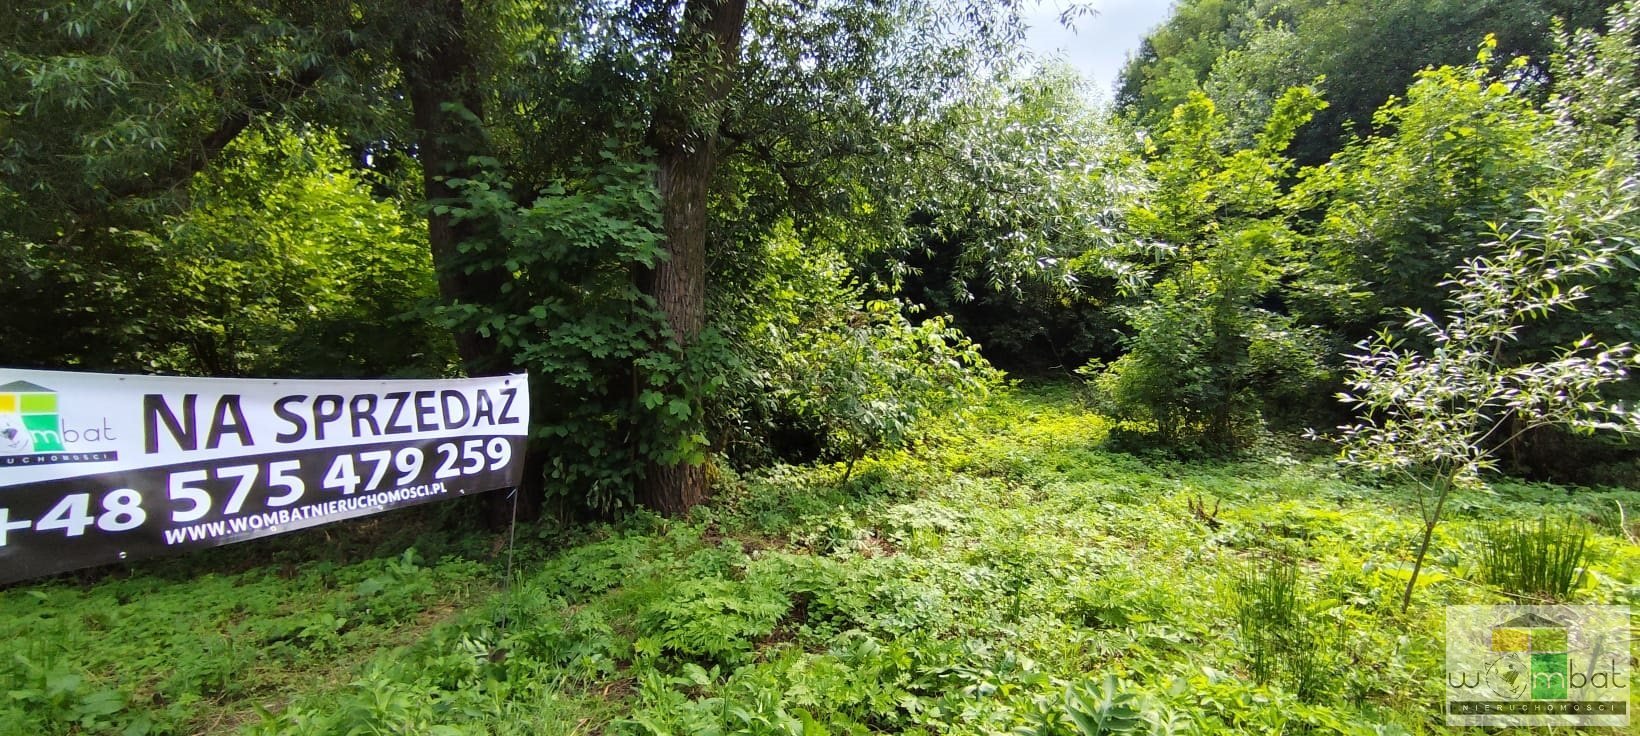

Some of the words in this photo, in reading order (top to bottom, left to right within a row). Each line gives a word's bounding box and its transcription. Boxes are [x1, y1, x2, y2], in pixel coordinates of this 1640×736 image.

[143, 394, 255, 454] NA
[273, 379, 520, 444] SPRZEDAŻ
[164, 482, 448, 545] WWW.WOMBATNIERUCHOMOSCI.PL
[168, 461, 306, 523] 575
[322, 447, 425, 495] 479
[434, 437, 512, 479] 259
